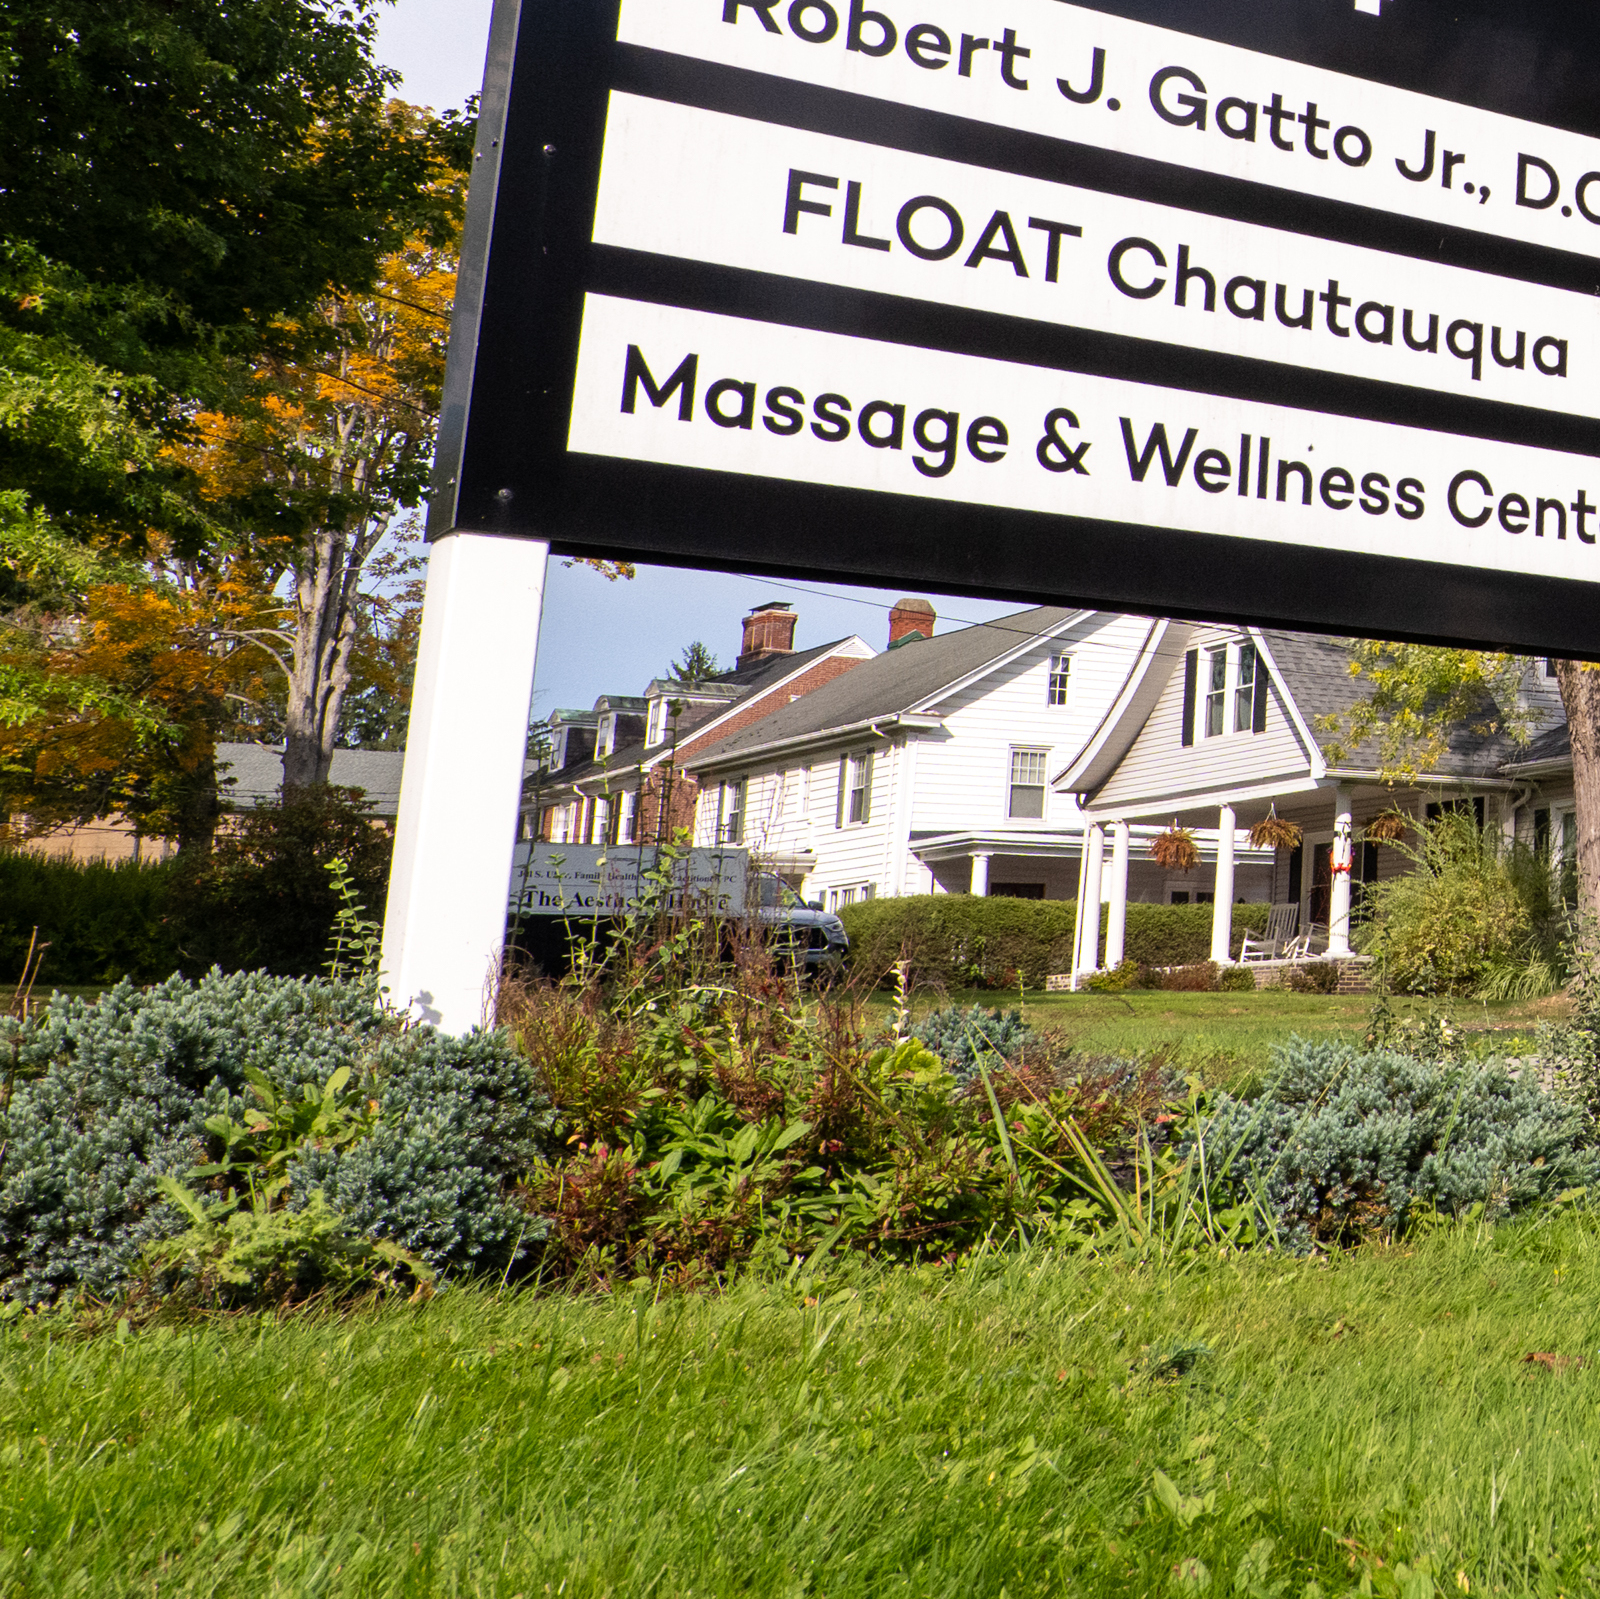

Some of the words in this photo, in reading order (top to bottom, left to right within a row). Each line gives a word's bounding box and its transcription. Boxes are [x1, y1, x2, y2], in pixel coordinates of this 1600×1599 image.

[1057, 48, 1121, 111] J.
[1150, 67, 1372, 167] Gatto
[1396, 130, 1491, 205] Jr.,
[783, 169, 1082, 283] FLOAT
[1108, 237, 1568, 381] Chautauqua
[621, 345, 1009, 478] Massage
[1037, 408, 1091, 476] &
[1120, 417, 1425, 520] Wellness
